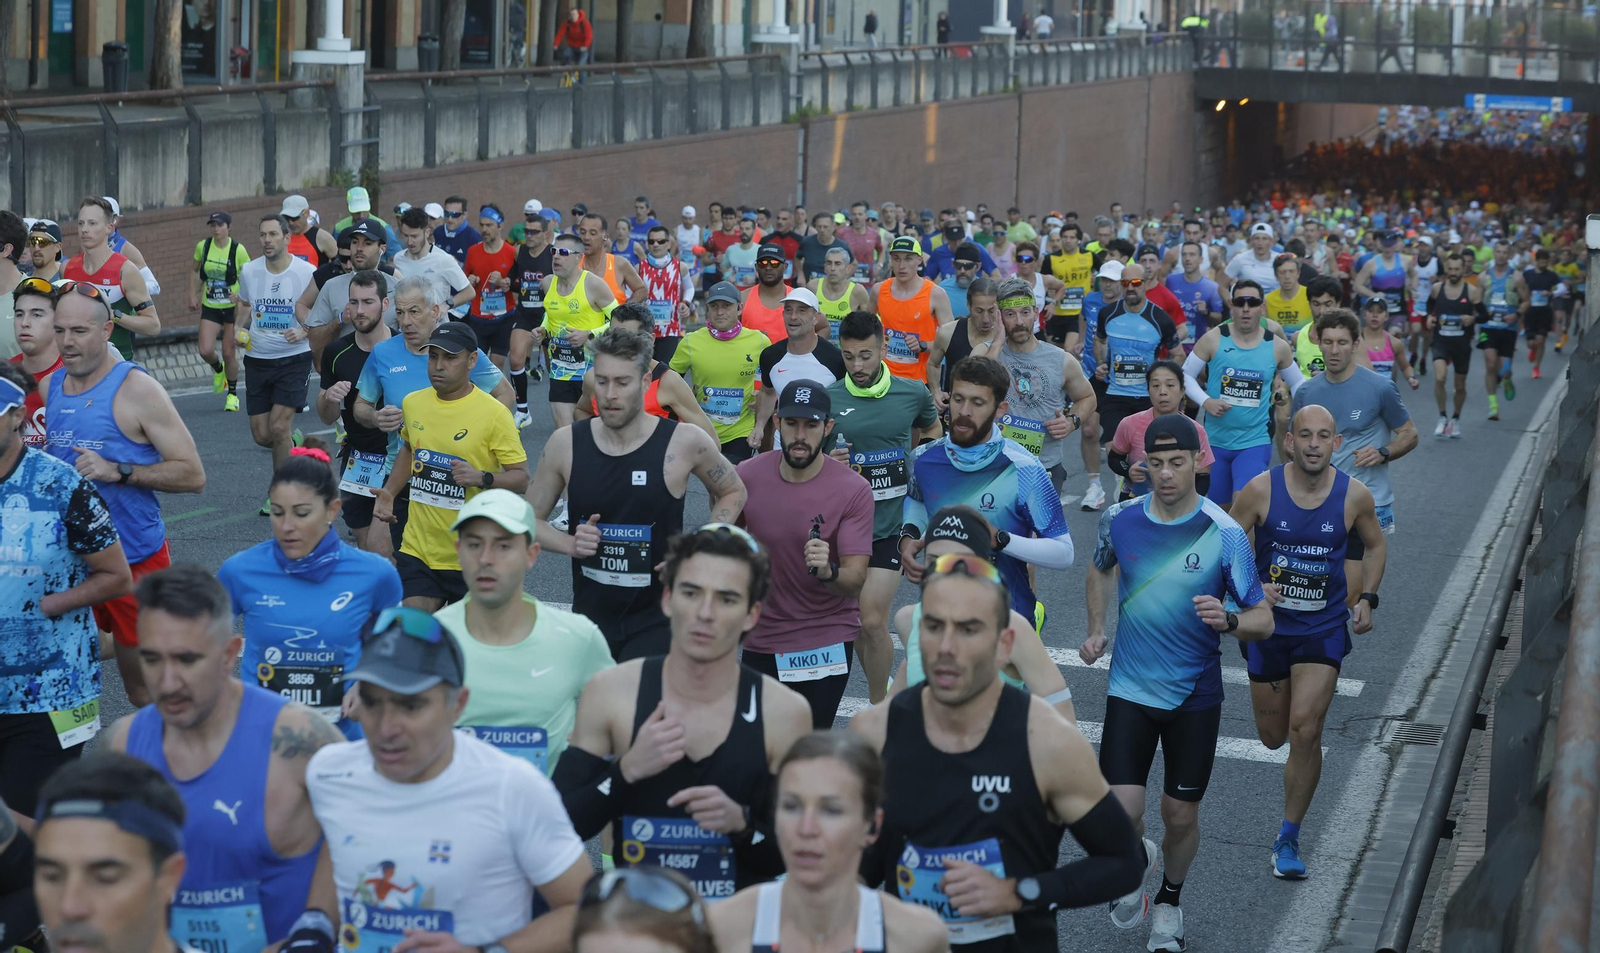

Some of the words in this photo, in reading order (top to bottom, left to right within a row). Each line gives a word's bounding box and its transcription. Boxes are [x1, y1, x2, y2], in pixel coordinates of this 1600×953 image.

[524, 271, 543, 281] RTC
[1277, 311, 1299, 319] CEJ
[259, 321, 289, 330] LAURENT
[389, 365, 407, 374] HOKA
[1236, 370, 1260, 378] ZURICH
[1223, 386, 1258, 398] SUSARTE
[1014, 418, 1042, 430] ZURICH
[1012, 431, 1027, 440] 2304
[362, 454, 384, 463] ZURICH
[432, 455, 451, 466] ZURI
[869, 450, 898, 462] ZURICH
[430, 470, 447, 480] 3962
[870, 467, 888, 476] 3505
[356, 474, 371, 485] JAN
[870, 476, 892, 489] JAVI
[411, 476, 465, 498] MUSTAPHA
[602, 527, 643, 538] ZURICH
[603, 546, 625, 556] 3319
[600, 556, 629, 572] TOM
[1291, 561, 1325, 572] ZURICH
[1290, 575, 1308, 586] 3475
[287, 651, 335, 662] ZURICH
[789, 653, 819, 668] KIKO
[821, 651, 833, 664] V.
[288, 673, 315, 685] 3856
[72, 703, 96, 723] SAID
[482, 731, 538, 744] ZURICH
[658, 854, 699, 869] 14587
[180, 886, 245, 906] ZURICH
[371, 912, 440, 931] ZURICH
